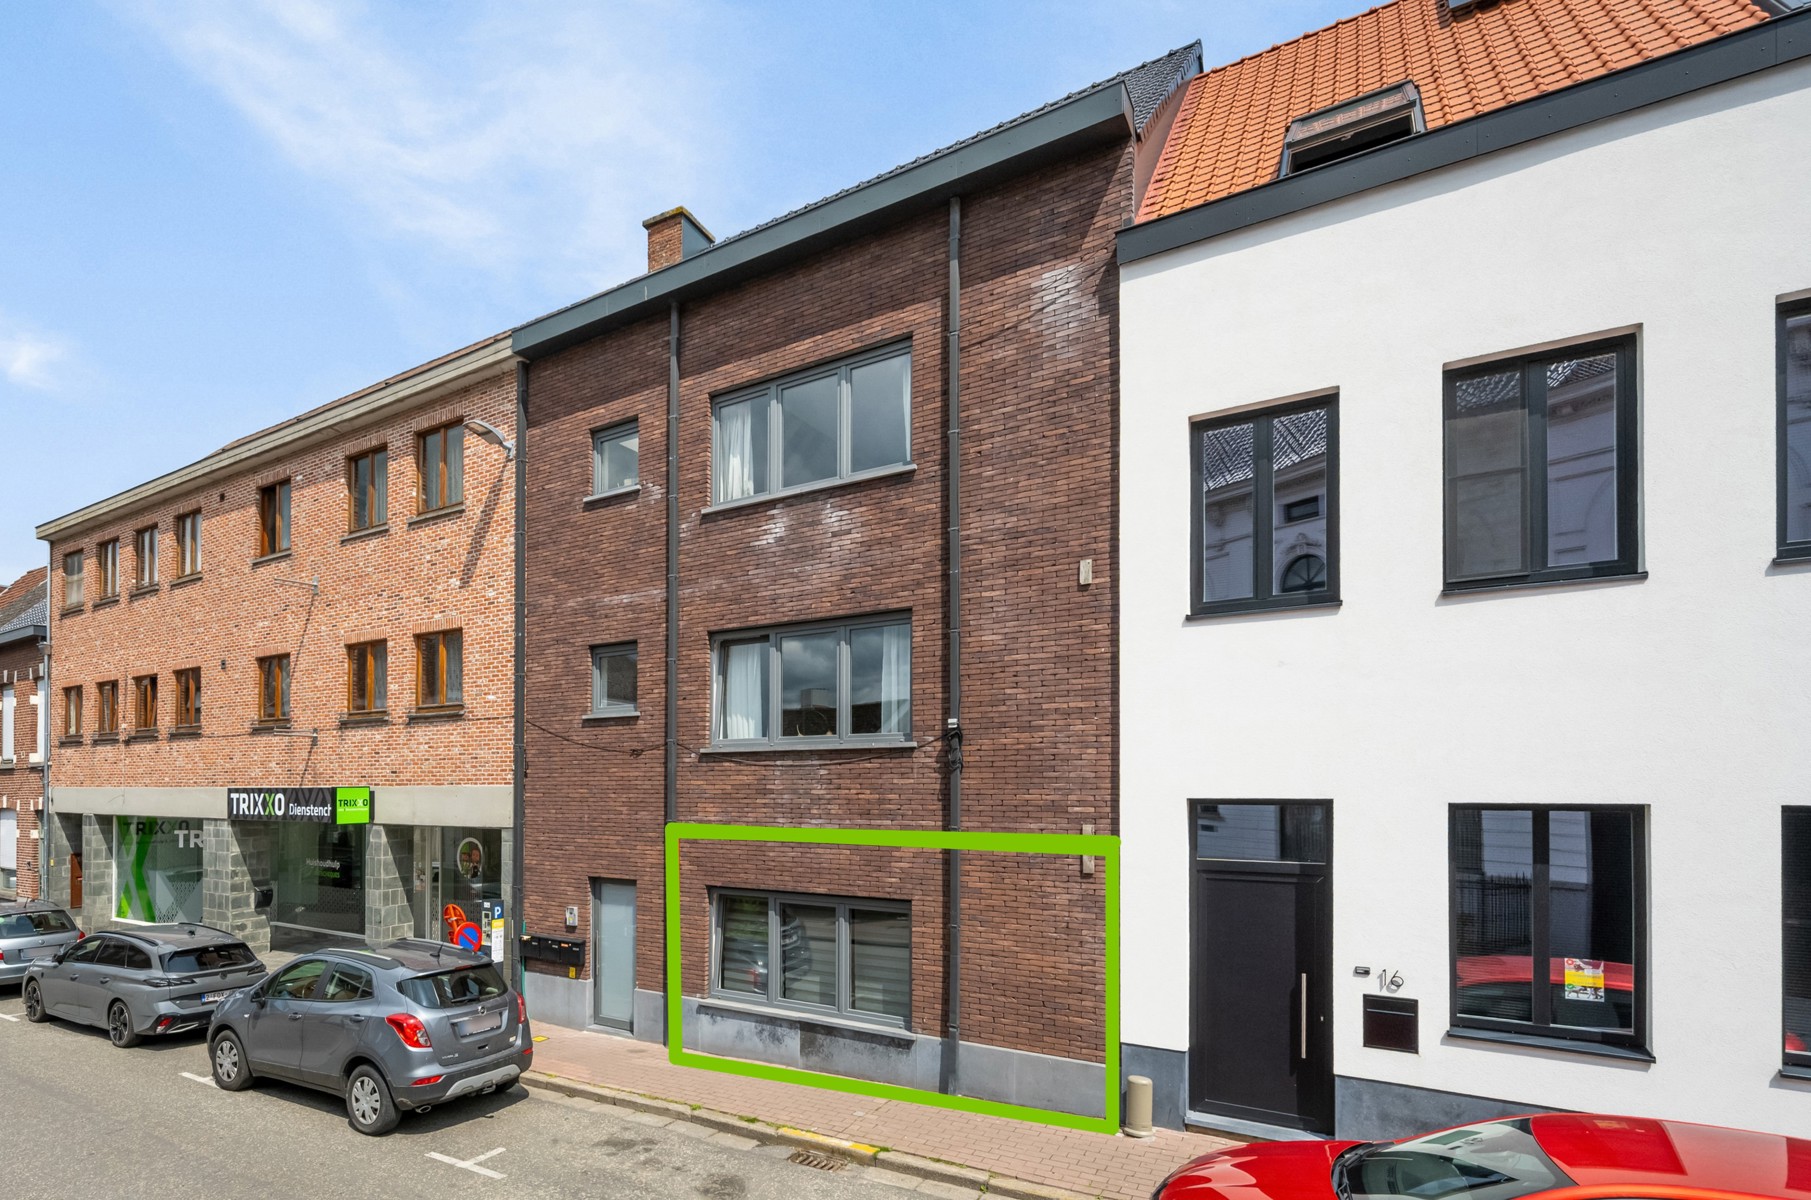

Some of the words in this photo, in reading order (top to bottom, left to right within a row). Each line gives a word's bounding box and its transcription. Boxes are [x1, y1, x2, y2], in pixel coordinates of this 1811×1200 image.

[230, 792, 285, 816] TRIXXO
[338, 798, 369, 807] TRIXXO
[494, 906, 502, 919] P
[1381, 968, 1405, 988] 16
